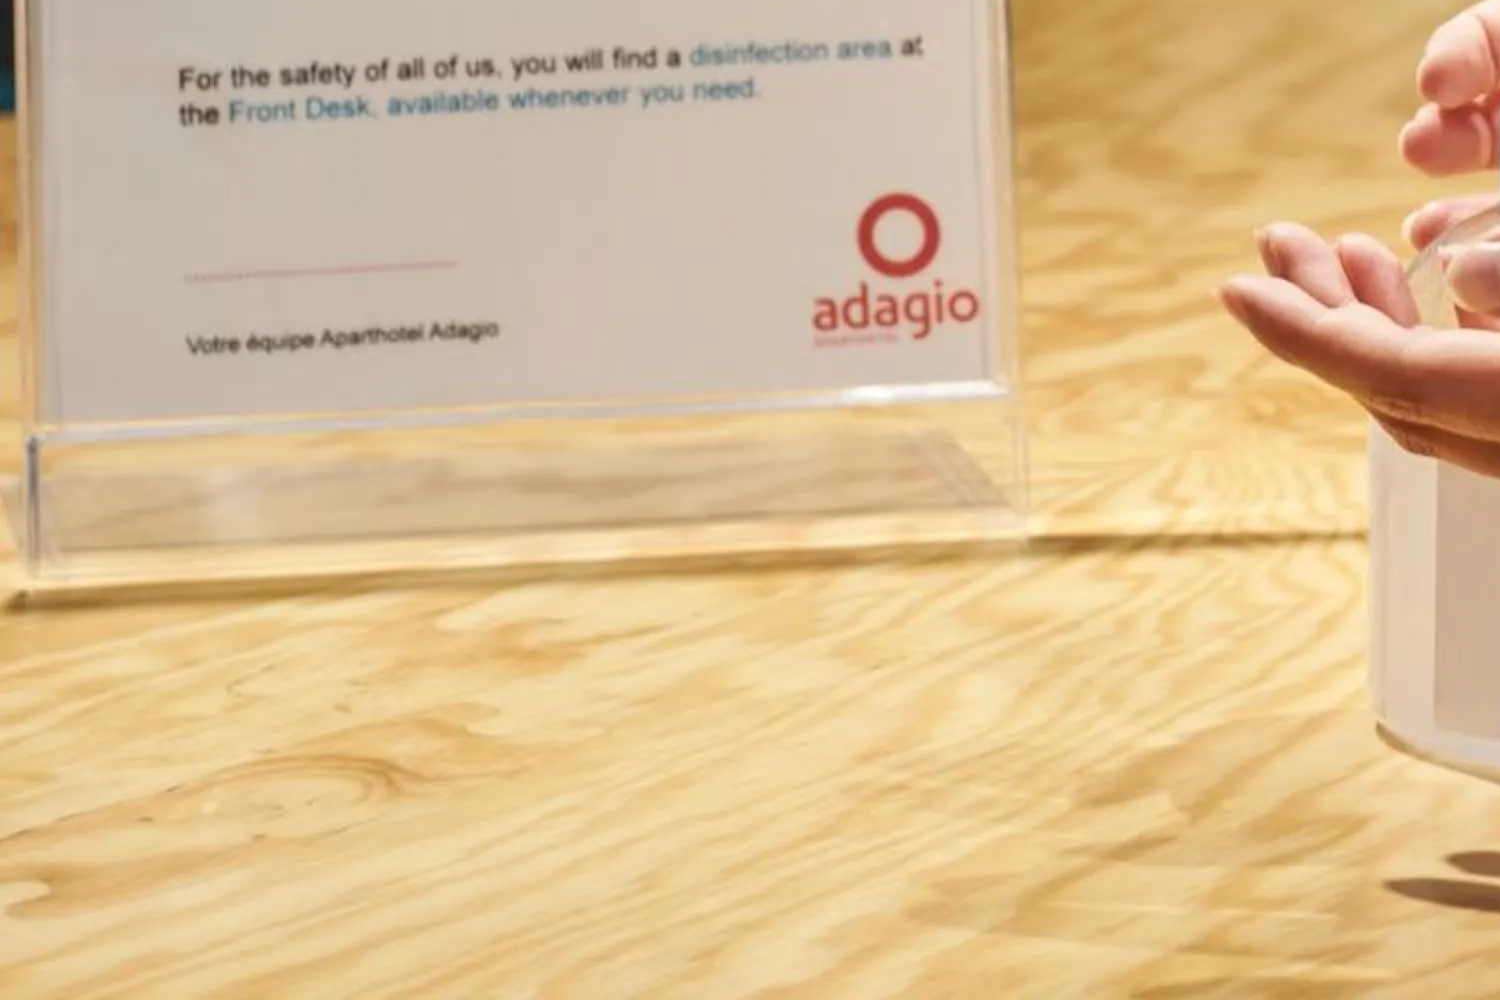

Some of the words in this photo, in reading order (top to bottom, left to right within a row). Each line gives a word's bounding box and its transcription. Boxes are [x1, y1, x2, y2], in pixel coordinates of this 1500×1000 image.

[178, 65, 223, 92] For
[230, 65, 272, 89] the
[279, 60, 357, 90] safety
[364, 57, 390, 83] of
[396, 56, 426, 82] all
[433, 54, 459, 80] of
[465, 58, 502, 78] us,
[510, 56, 557, 82] you
[564, 48, 604, 72] will
[612, 46, 658, 70] find
[665, 49, 682, 69] a
[689, 42, 828, 66] disinfection
[838, 41, 892, 59] area
[900, 34, 924, 57] at
[178, 102, 221, 127] the
[229, 100, 296, 124] Front
[306, 96, 376, 121] Desk,
[388, 90, 499, 115] available
[509, 88, 628, 110] whenever
[641, 85, 684, 108] you
[693, 77, 761, 101] need.
[812, 278, 979, 341] adagio
[186, 335, 240, 356] Votre
[320, 324, 425, 349] Aparthotel
[429, 320, 500, 344] Adagio
